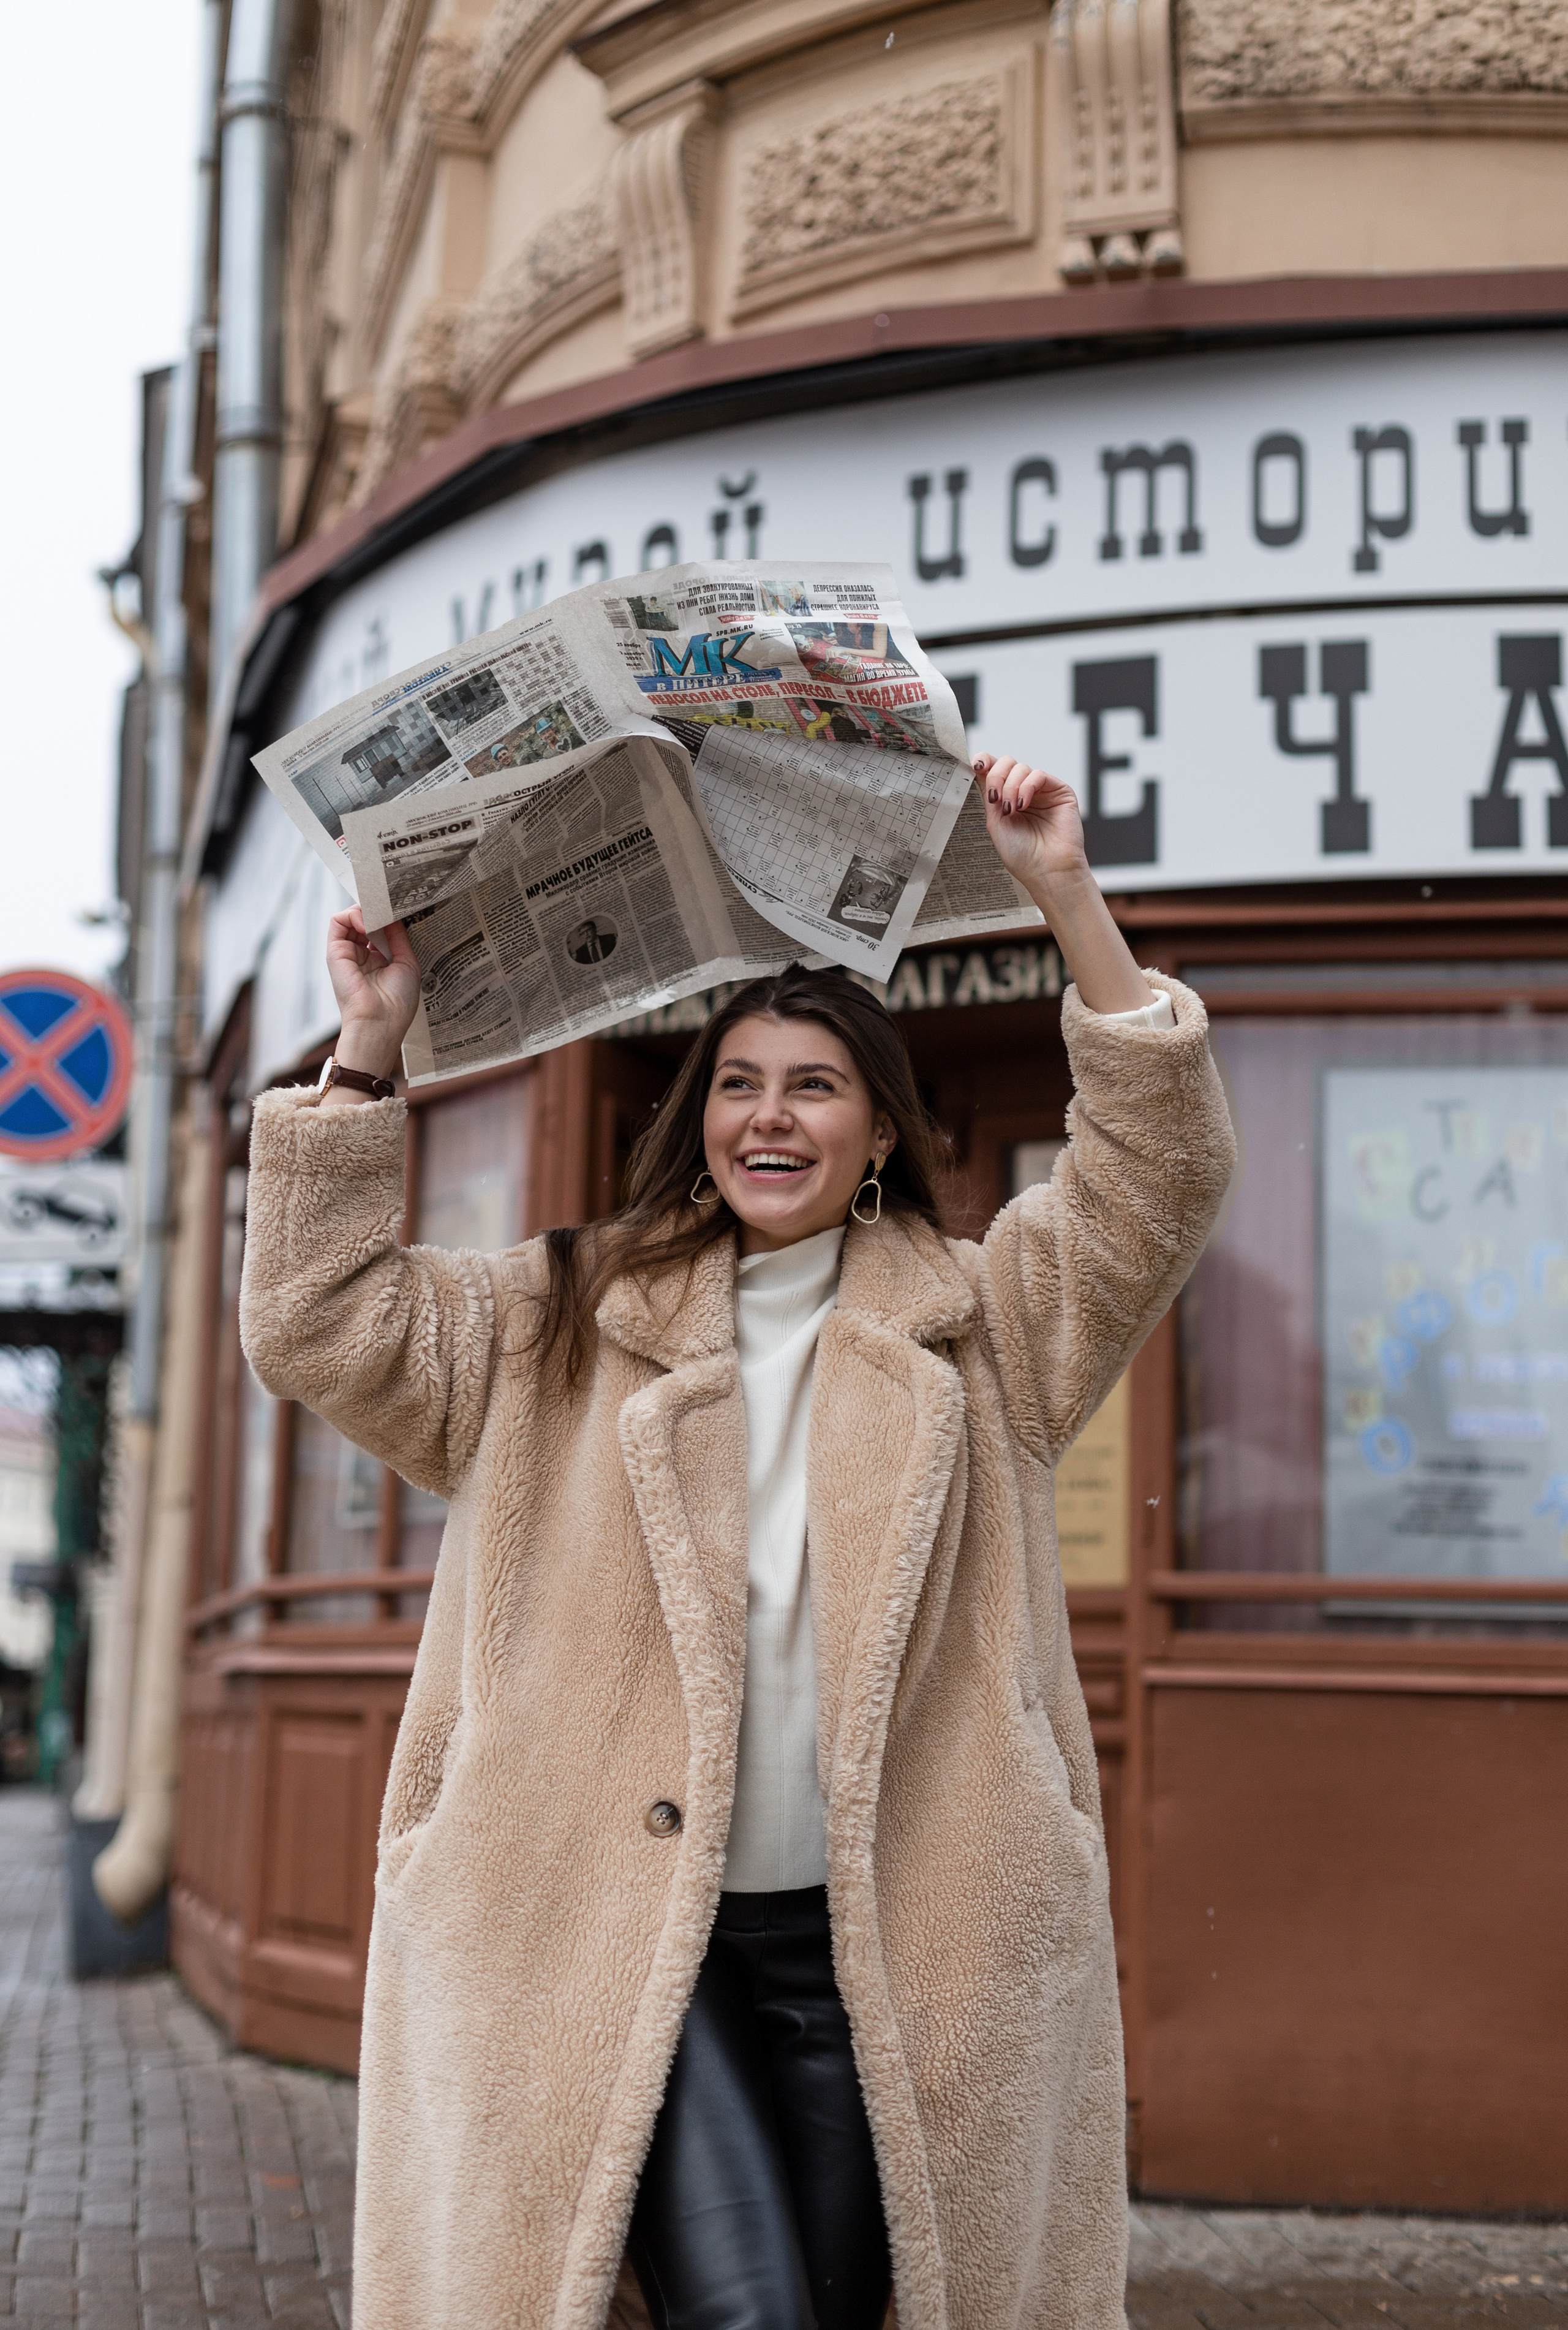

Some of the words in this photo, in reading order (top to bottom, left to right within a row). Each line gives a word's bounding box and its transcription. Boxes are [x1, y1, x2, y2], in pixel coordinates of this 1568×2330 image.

[909, 415, 1568, 581] истори
[677, 602, 685, 610] ИЗ
[687, 599, 698, 608] ПНИ
[700, 595, 717, 605] РЕБЯТ
[718, 593, 739, 603] ЖИЗНЬ
[740, 592, 755, 602] ДОМА
[688, 587, 701, 598] ДЛЯ
[837, 594, 848, 603] ДЛЯ
[849, 594, 876, 602] ПОЖИЛЫХ
[699, 607, 716, 616] СТАЛА
[718, 603, 756, 613] РЕАЛЬНОСТЬЮ
[519, 619, 552, 635] www.mk.ru
[716, 624, 753, 637] SPB.MK.RU
[646, 632, 755, 677] МК
[673, 673, 745, 690] ПИТЕРЕ
[844, 672, 866, 683] МАГИЯ
[866, 670, 876, 680] ВО
[876, 669, 897, 679] ВРЕМЯ
[425, 686, 442, 698] МОСКВЕ
[646, 692, 712, 706] НЕДОСОЛ
[713, 690, 732, 702] НА
[733, 683, 781, 699] СТОЛЕ,
[778, 681, 837, 700] ПЕРЕСОЛ
[846, 689, 858, 704] В
[858, 681, 929, 709] БЮДЖЕТЕ
[948, 634, 1568, 866] ЕЧА
[514, 777, 551, 797] ОСТРЫЙ
[522, 811, 539, 828] сайтов
[538, 795, 557, 814] нанесет
[557, 784, 570, 799] вред
[568, 768, 586, 787] прежде
[510, 803, 529, 824] НАЗЛО
[529, 789, 546, 808] ГУГЛУ
[525, 818, 539, 833] всего
[538, 795, 565, 822] российской
[564, 774, 588, 797] экономике
[383, 820, 472, 852] NON-STOP
[526, 866, 573, 900] МРАЧНОЕ
[573, 842, 619, 874] БУДУЩЕЕ
[617, 826, 654, 852] ГЕЙТСА
[546, 878, 579, 899] Миллиардер
[579, 868, 602, 882] сравнил
[601, 853, 628, 872] грядущие
[626, 838, 656, 857] изменения
[570, 874, 600, 895] событиями
[599, 865, 619, 880] Второй
[619, 853, 641, 869] мировой
[641, 844, 658, 858] войны
[867, 940, 880, 951] 30
